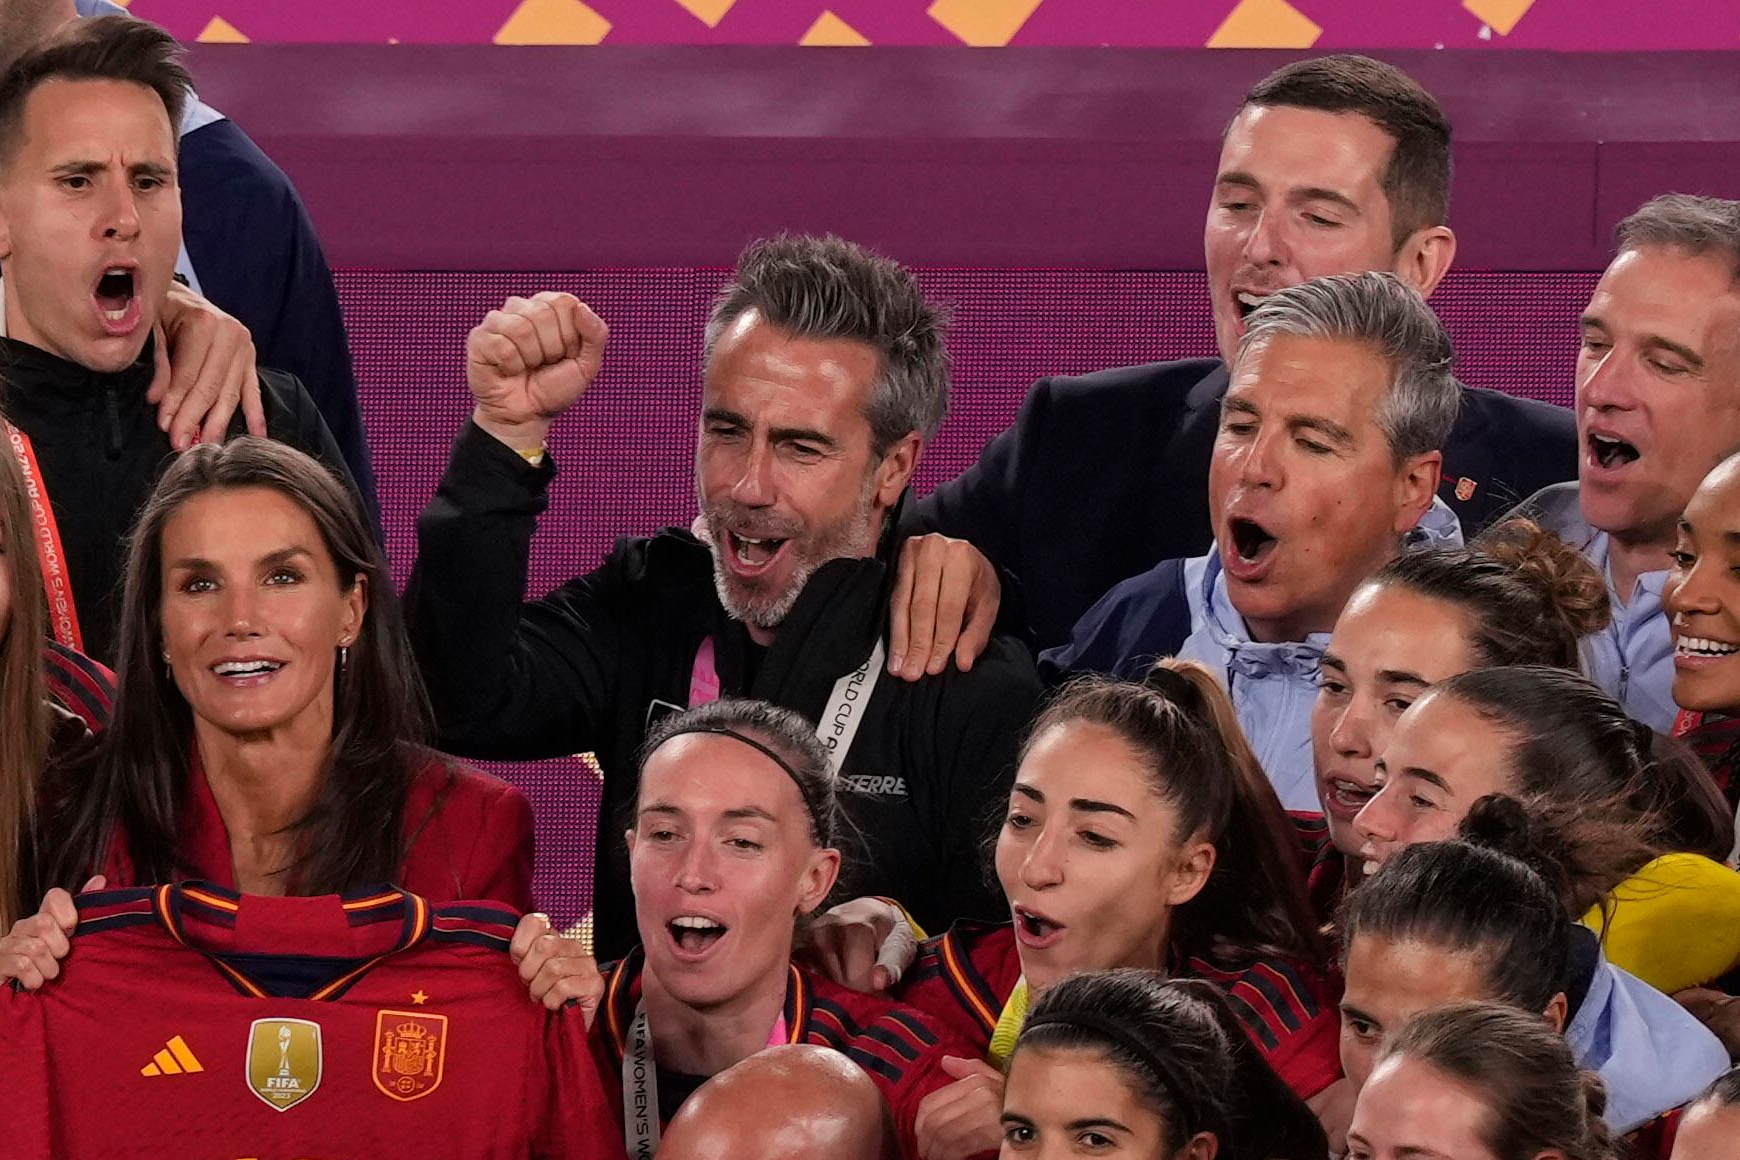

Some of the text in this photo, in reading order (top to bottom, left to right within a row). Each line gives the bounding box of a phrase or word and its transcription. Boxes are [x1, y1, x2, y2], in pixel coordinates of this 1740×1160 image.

[30, 500, 48, 528] CUP
[39, 529, 61, 577] WORLD
[845, 657, 873, 701] ORLD
[824, 703, 853, 737] CUP
[267, 1078, 299, 1089] FIFA
[634, 1050, 649, 1135] WOMEN'S
